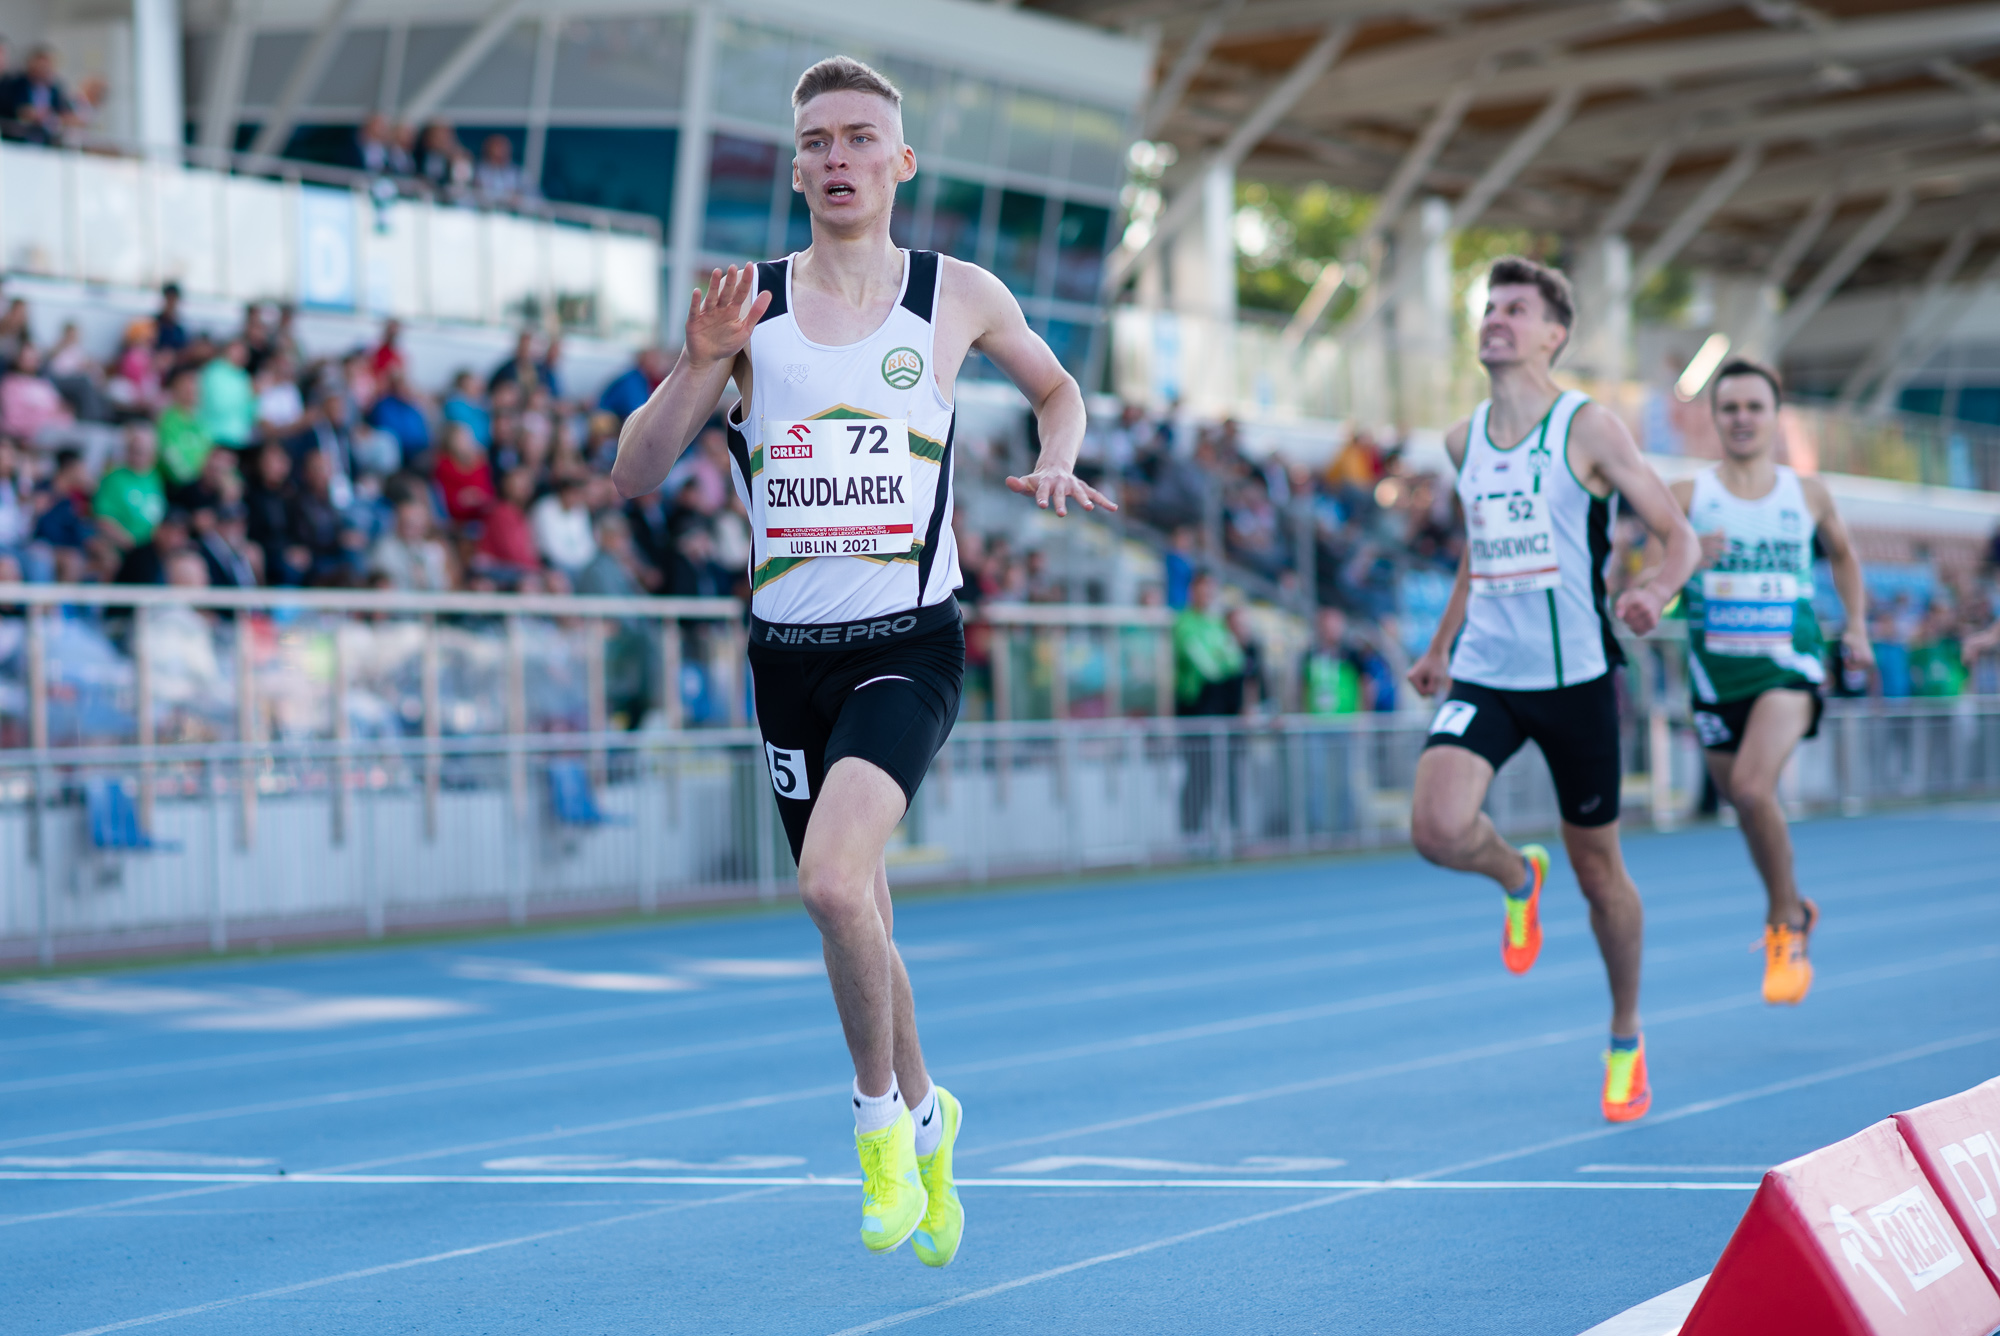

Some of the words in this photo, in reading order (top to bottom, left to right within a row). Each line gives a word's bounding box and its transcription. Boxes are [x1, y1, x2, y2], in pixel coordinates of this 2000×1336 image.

[888, 352, 918, 371] RKS
[771, 446, 811, 458] ORLEN
[846, 425, 889, 455] 72
[767, 475, 905, 508] SZKUDLAREK
[1507, 500, 1536, 522] 52
[790, 540, 837, 554] LUBLIN
[842, 538, 878, 553] 2021
[765, 626, 843, 645] NIKE
[844, 615, 918, 643] PRO
[773, 749, 797, 794] 5
[1881, 1200, 1954, 1276] ORLEN
